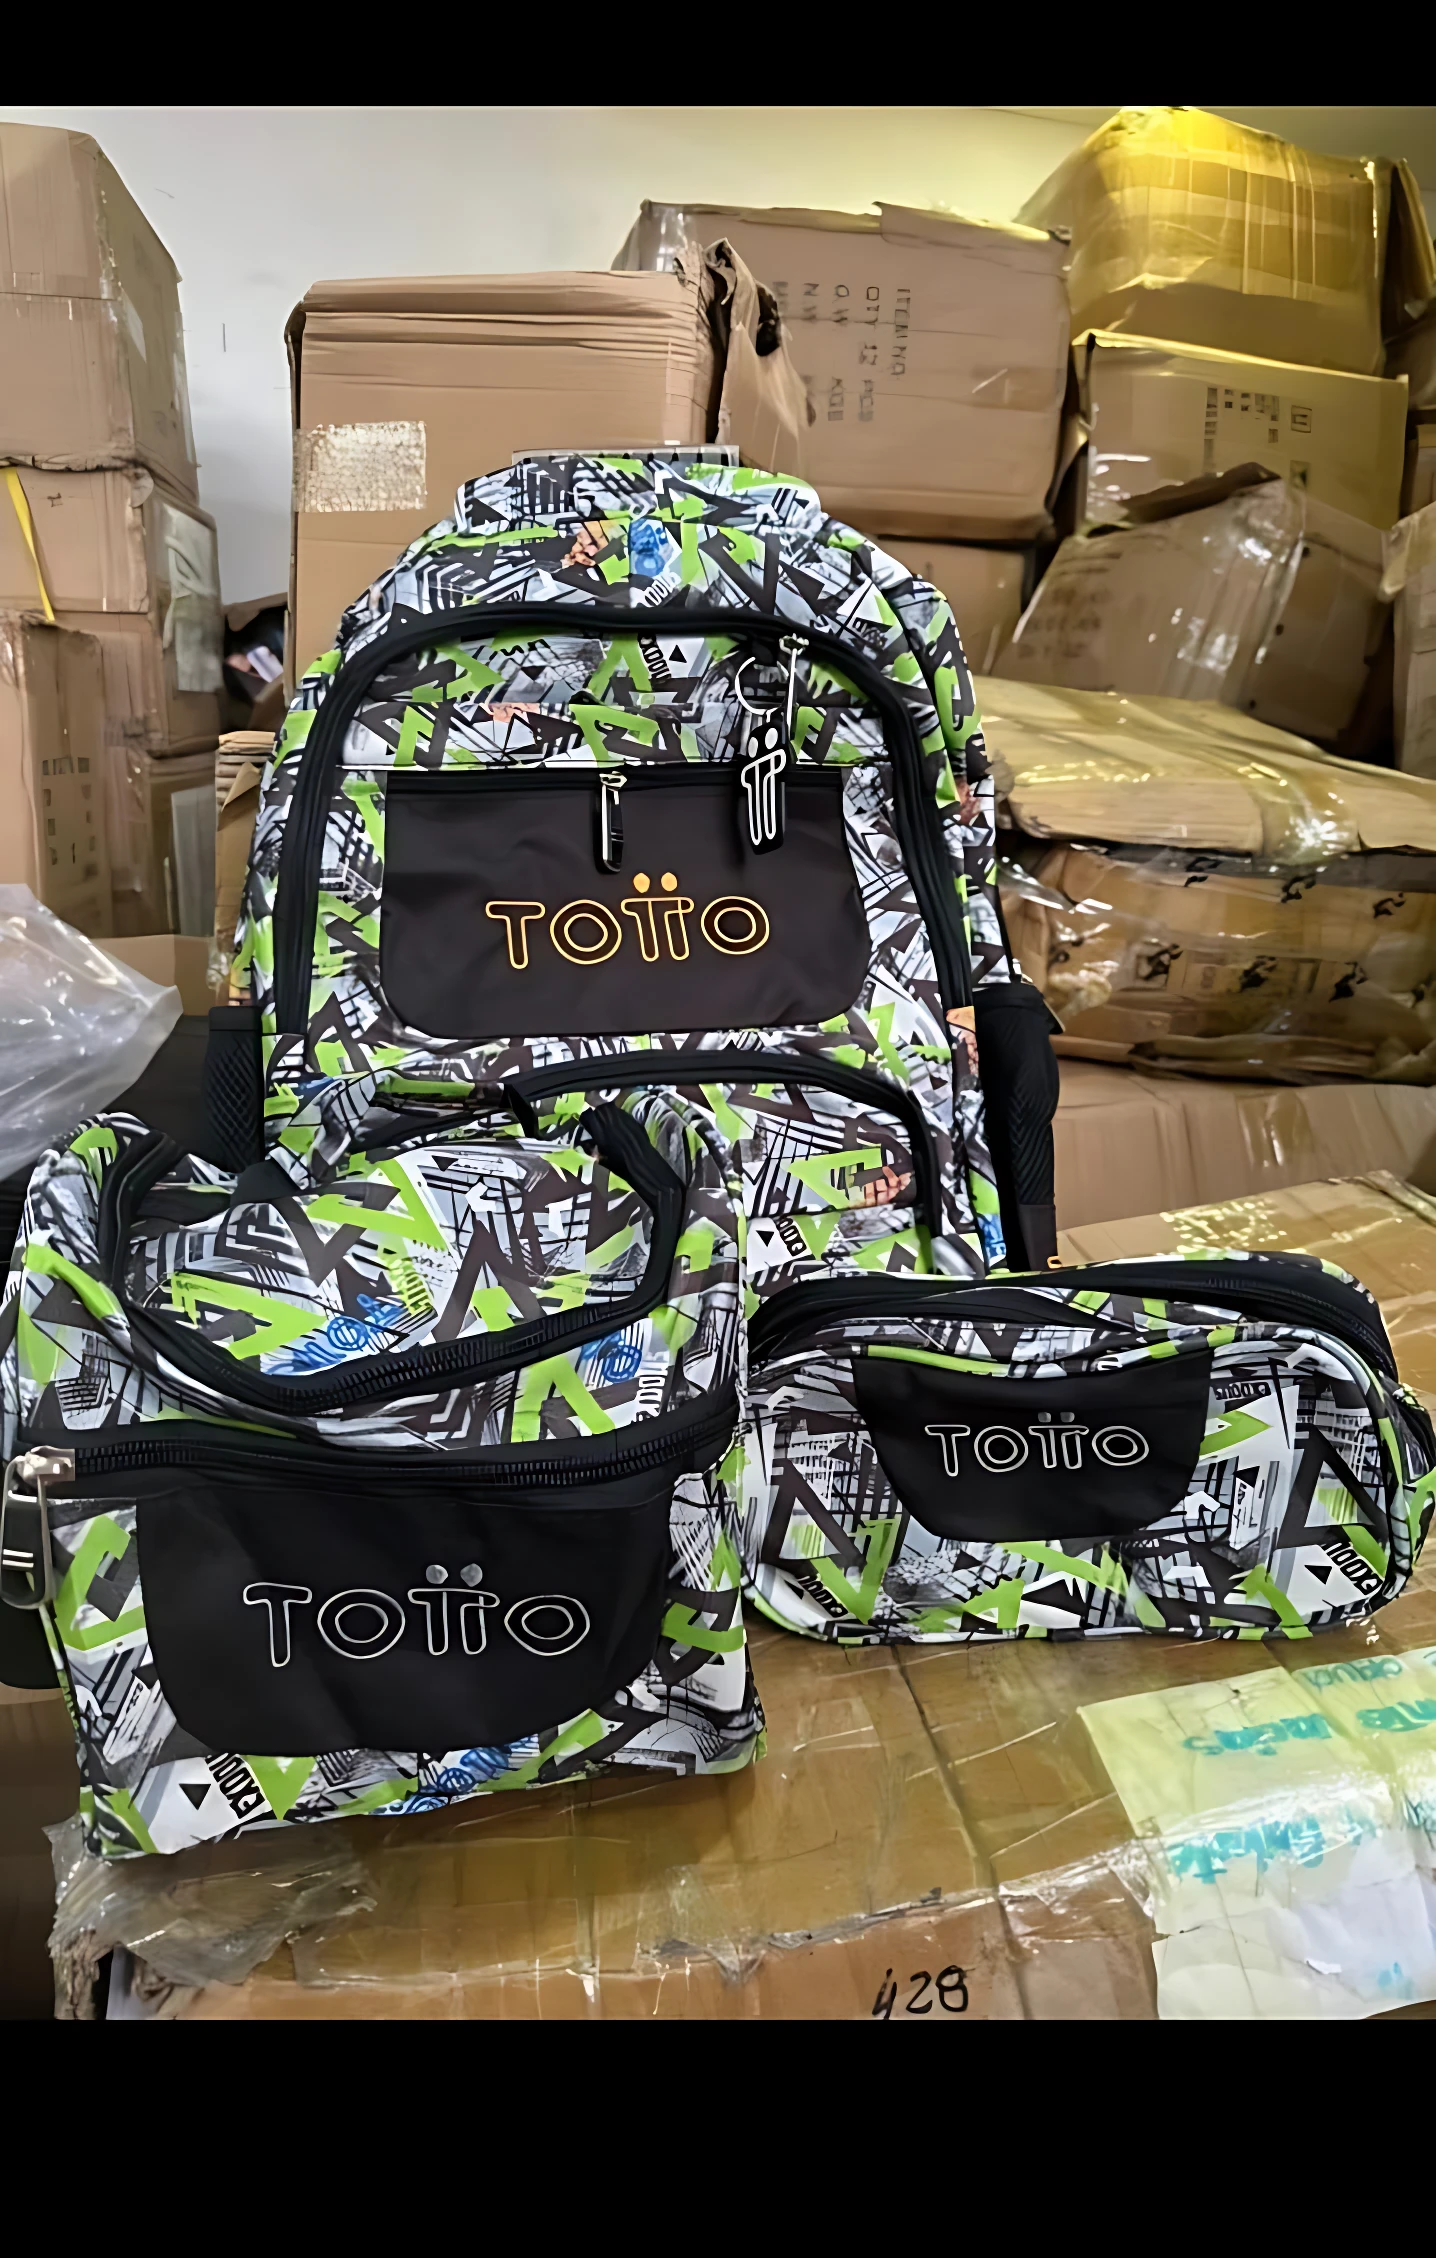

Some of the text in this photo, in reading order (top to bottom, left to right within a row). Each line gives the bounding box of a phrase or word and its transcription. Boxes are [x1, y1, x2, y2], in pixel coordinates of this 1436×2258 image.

[485, 872, 770, 969] TOTTO
[924, 1411, 1150, 1477] TOTTO
[243, 1563, 590, 1667] TOTTO
